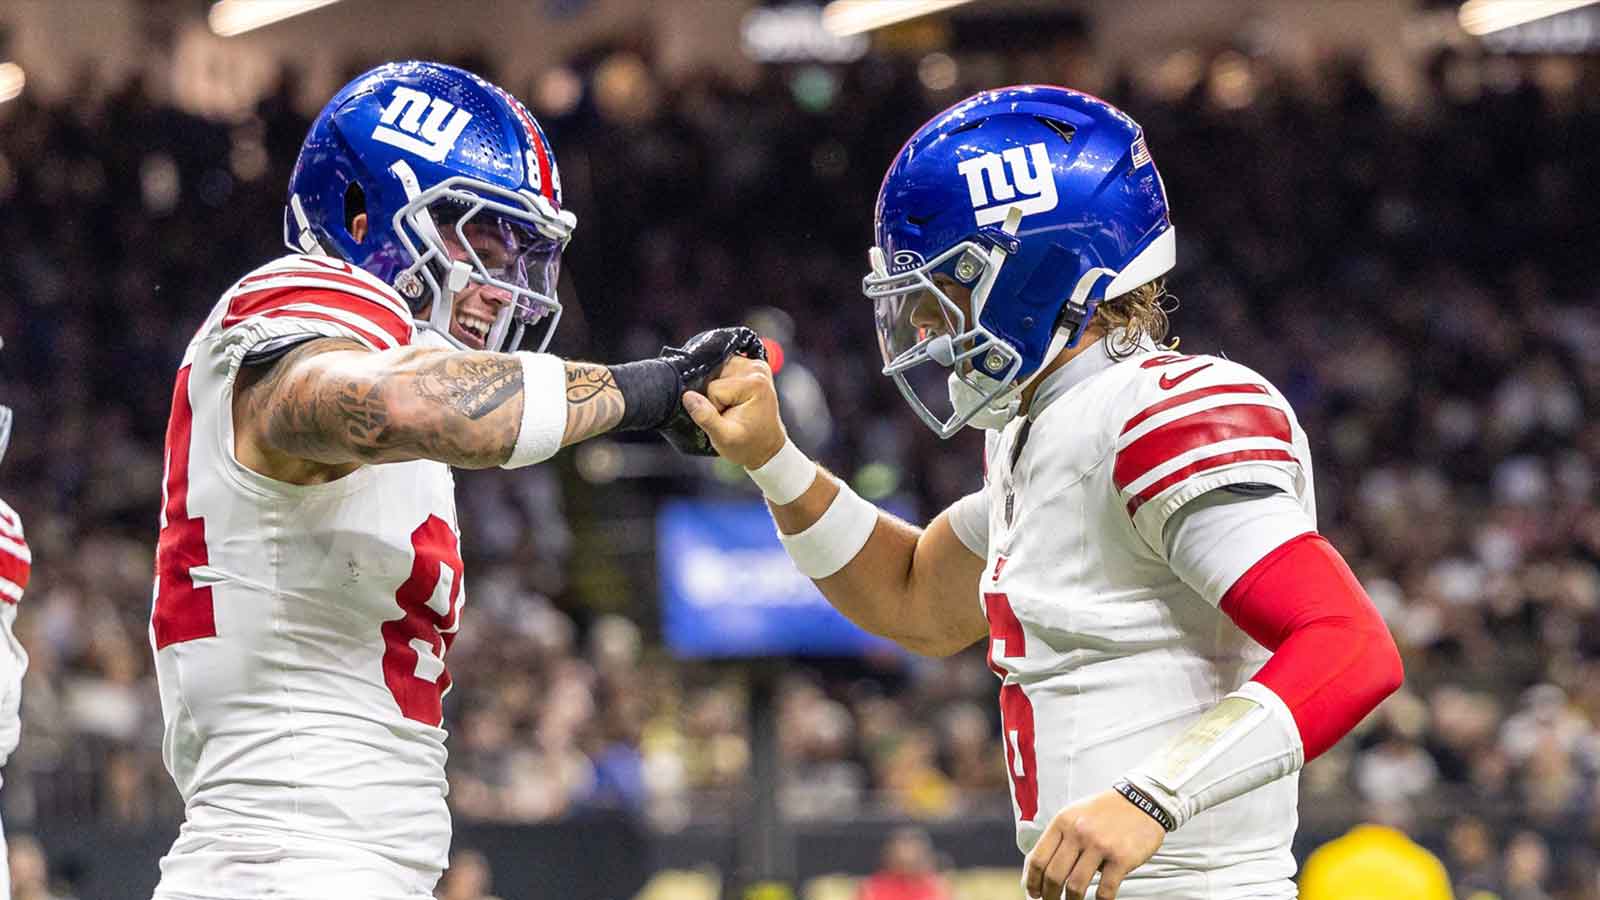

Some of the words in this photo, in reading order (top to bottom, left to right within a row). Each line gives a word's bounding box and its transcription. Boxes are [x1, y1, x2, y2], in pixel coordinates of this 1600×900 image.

[957, 142, 1059, 227] ny
[377, 513, 465, 728] 8
[1128, 791, 1153, 812] OVER
